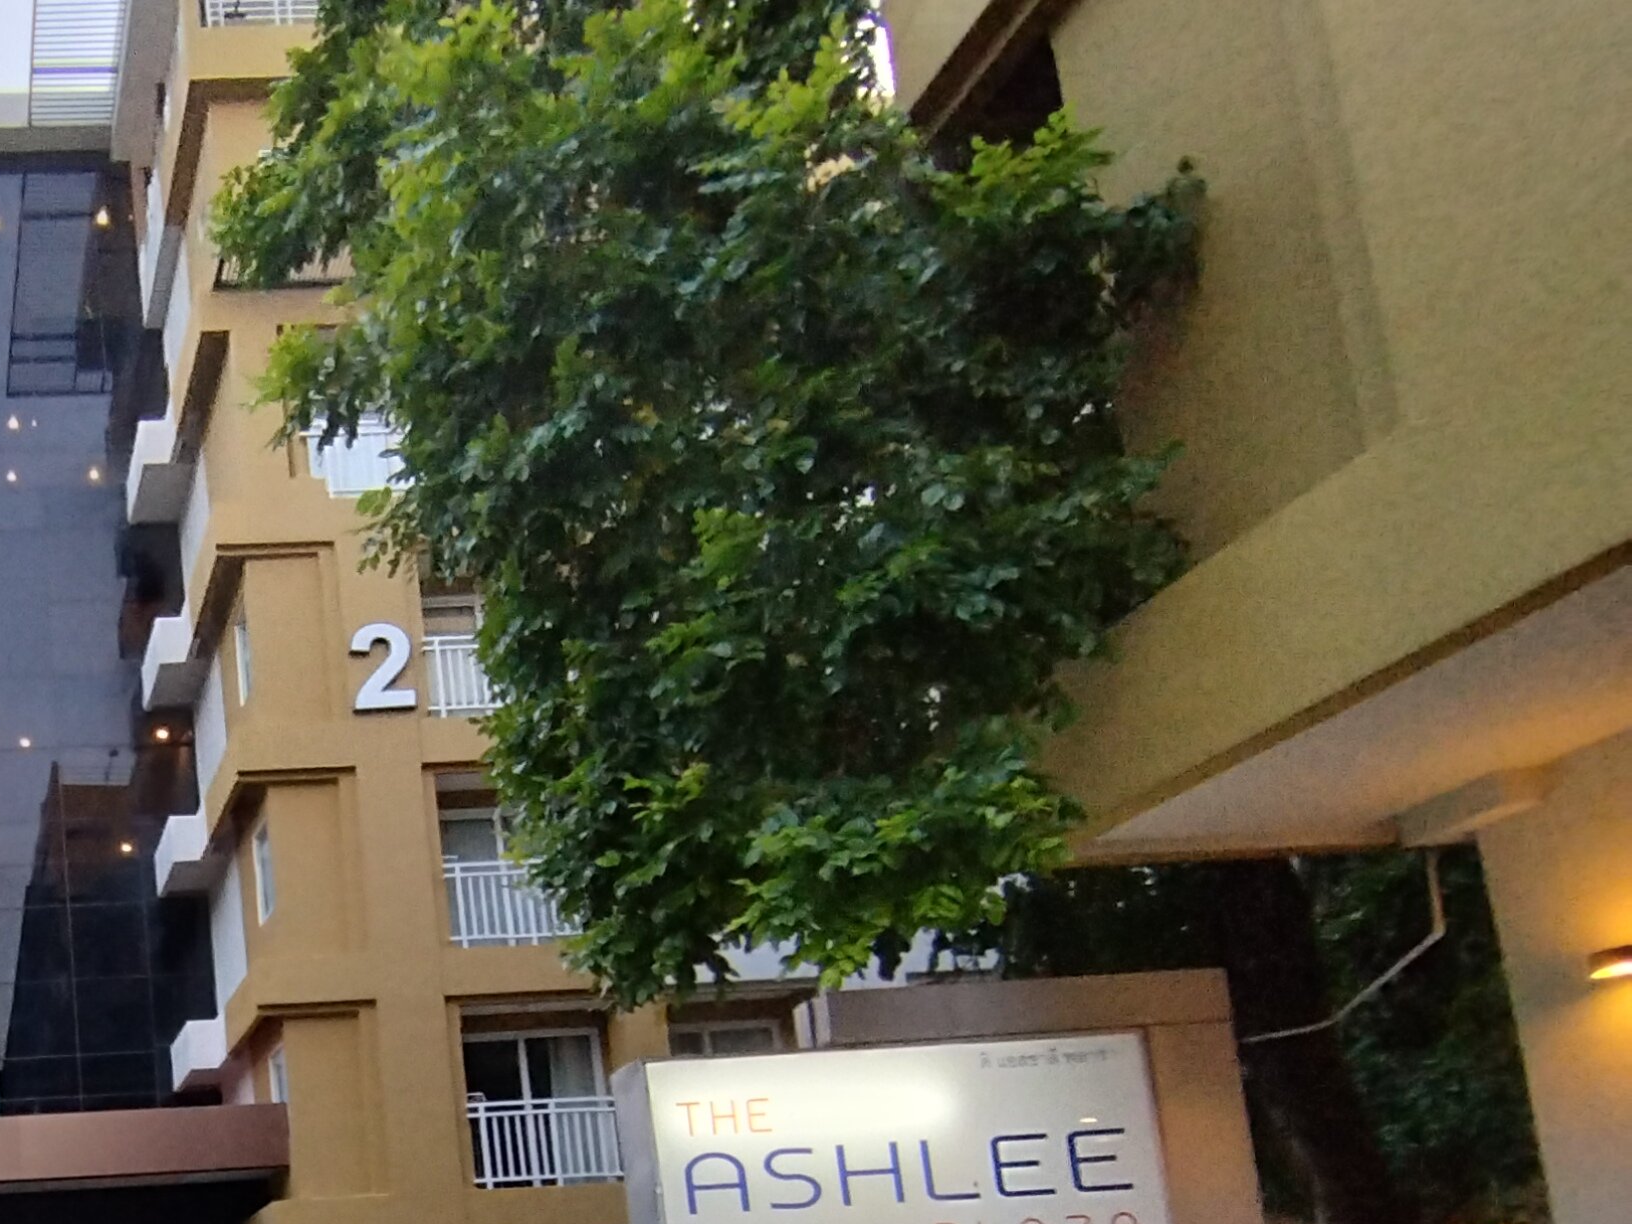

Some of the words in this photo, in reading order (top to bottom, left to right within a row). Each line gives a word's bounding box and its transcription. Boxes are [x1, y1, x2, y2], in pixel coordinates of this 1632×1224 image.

[349, 622, 417, 713] 2
[675, 1097, 773, 1137] THE
[684, 1127, 1134, 1215] ASHLEE
